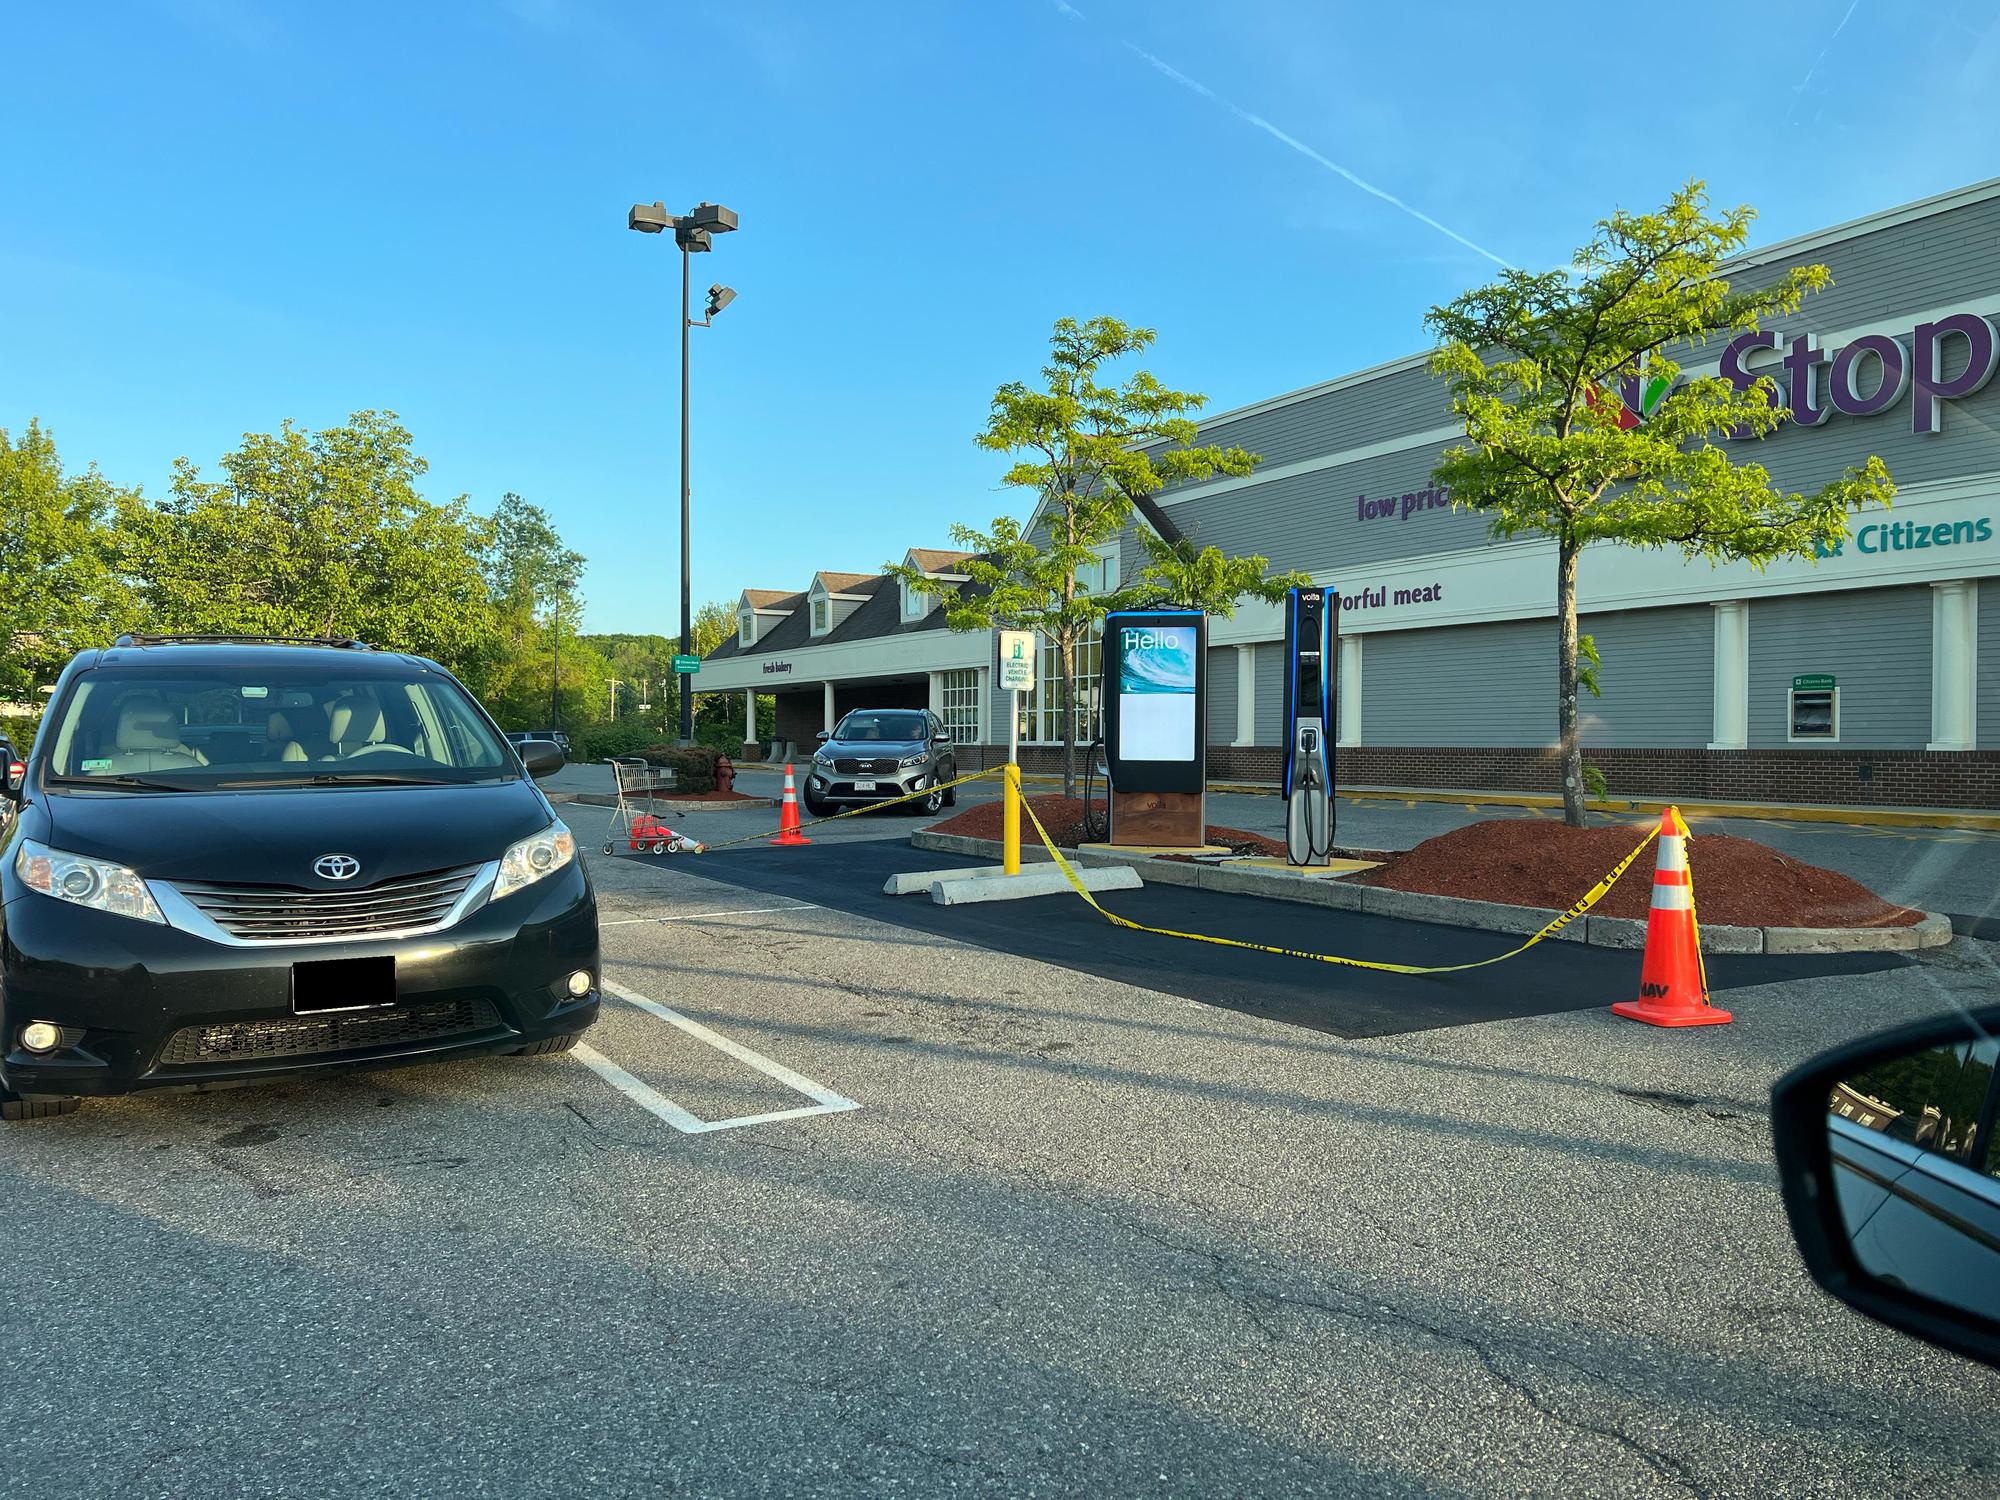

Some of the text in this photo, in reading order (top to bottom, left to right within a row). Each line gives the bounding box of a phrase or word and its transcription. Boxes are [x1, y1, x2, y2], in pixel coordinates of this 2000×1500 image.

[1718, 312, 1998, 440] Stop
[1358, 480, 1450, 521] low pric
[1857, 517, 1993, 554] Citizens
[1302, 593, 1320, 601] volta
[1393, 582, 1442, 606] meat
[1125, 631, 1179, 650] Hello
